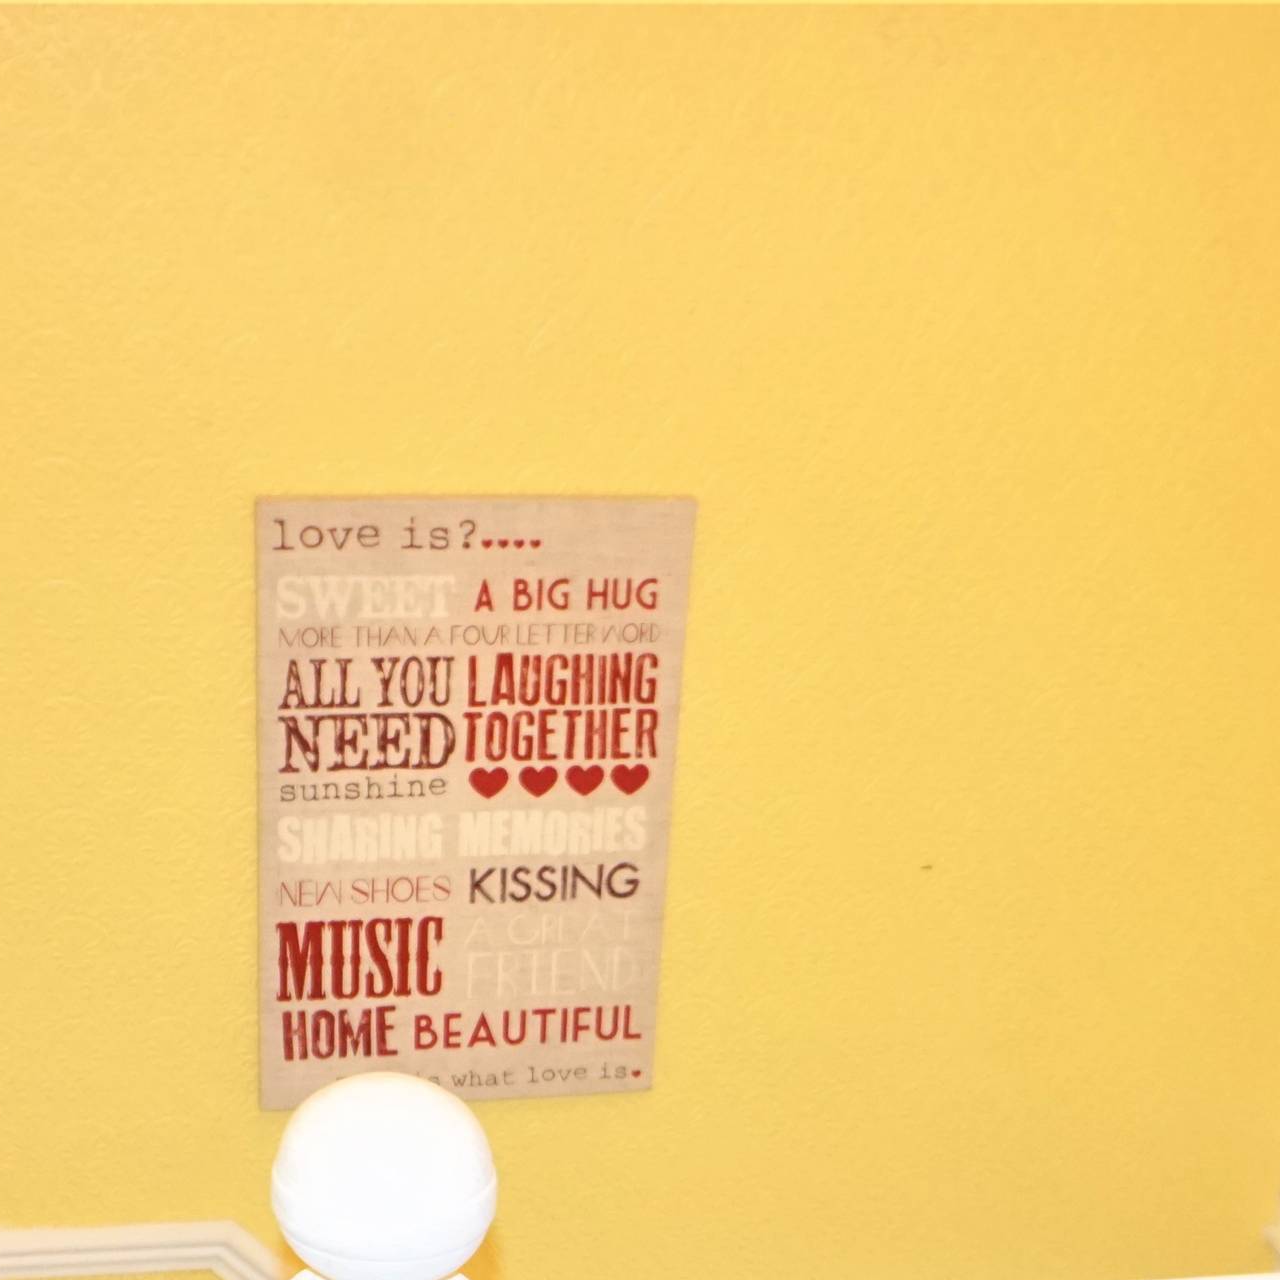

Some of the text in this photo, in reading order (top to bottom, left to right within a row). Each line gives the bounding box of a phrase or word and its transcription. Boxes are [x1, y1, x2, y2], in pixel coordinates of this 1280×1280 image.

[273, 518, 381, 551] love
[276, 574, 456, 620] SWEET
[474, 577, 658, 613] A BIG HUG
[278, 622, 660, 648] MORE THAN A FOUR LETTER WORD
[278, 655, 455, 710] ALL YOU
[467, 652, 658, 708] LAUGHING
[278, 712, 456, 773] NEED
[463, 708, 658, 763] TOGETHER
[279, 774, 448, 803] sunshine
[277, 806, 648, 865] SHARING MEMORIES
[278, 874, 452, 907] NEW SHOES
[468, 862, 641, 904] KISSING
[276, 916, 443, 1001] MUSIC
[466, 946, 636, 999] FRIEND
[282, 1005, 398, 1061] HOME
[414, 1005, 642, 1051] BEAUTIFUL
[451, 1070, 515, 1088] what
[527, 1065, 588, 1084] love
